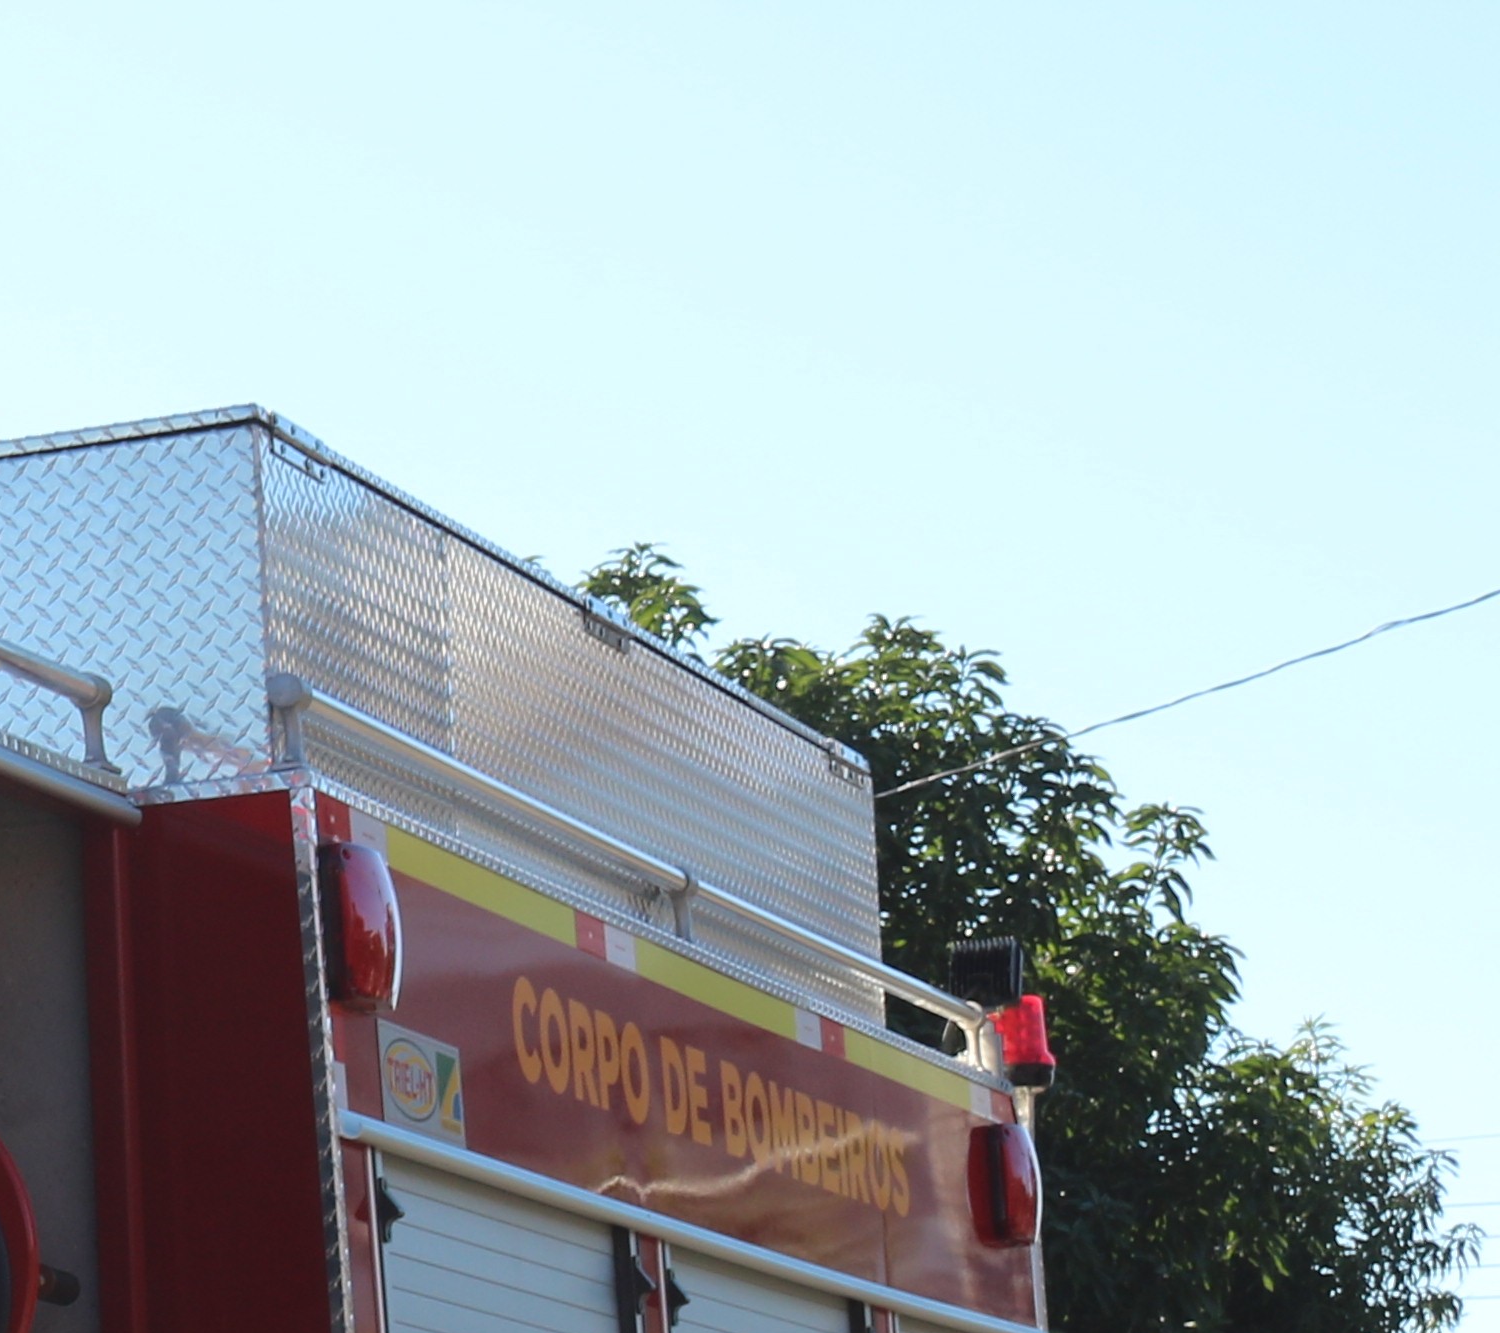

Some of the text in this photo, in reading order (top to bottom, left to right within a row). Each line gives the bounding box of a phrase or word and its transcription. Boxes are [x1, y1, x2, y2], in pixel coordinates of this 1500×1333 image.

[512, 976, 910, 1218] CORPO DE BOMBEIROS
